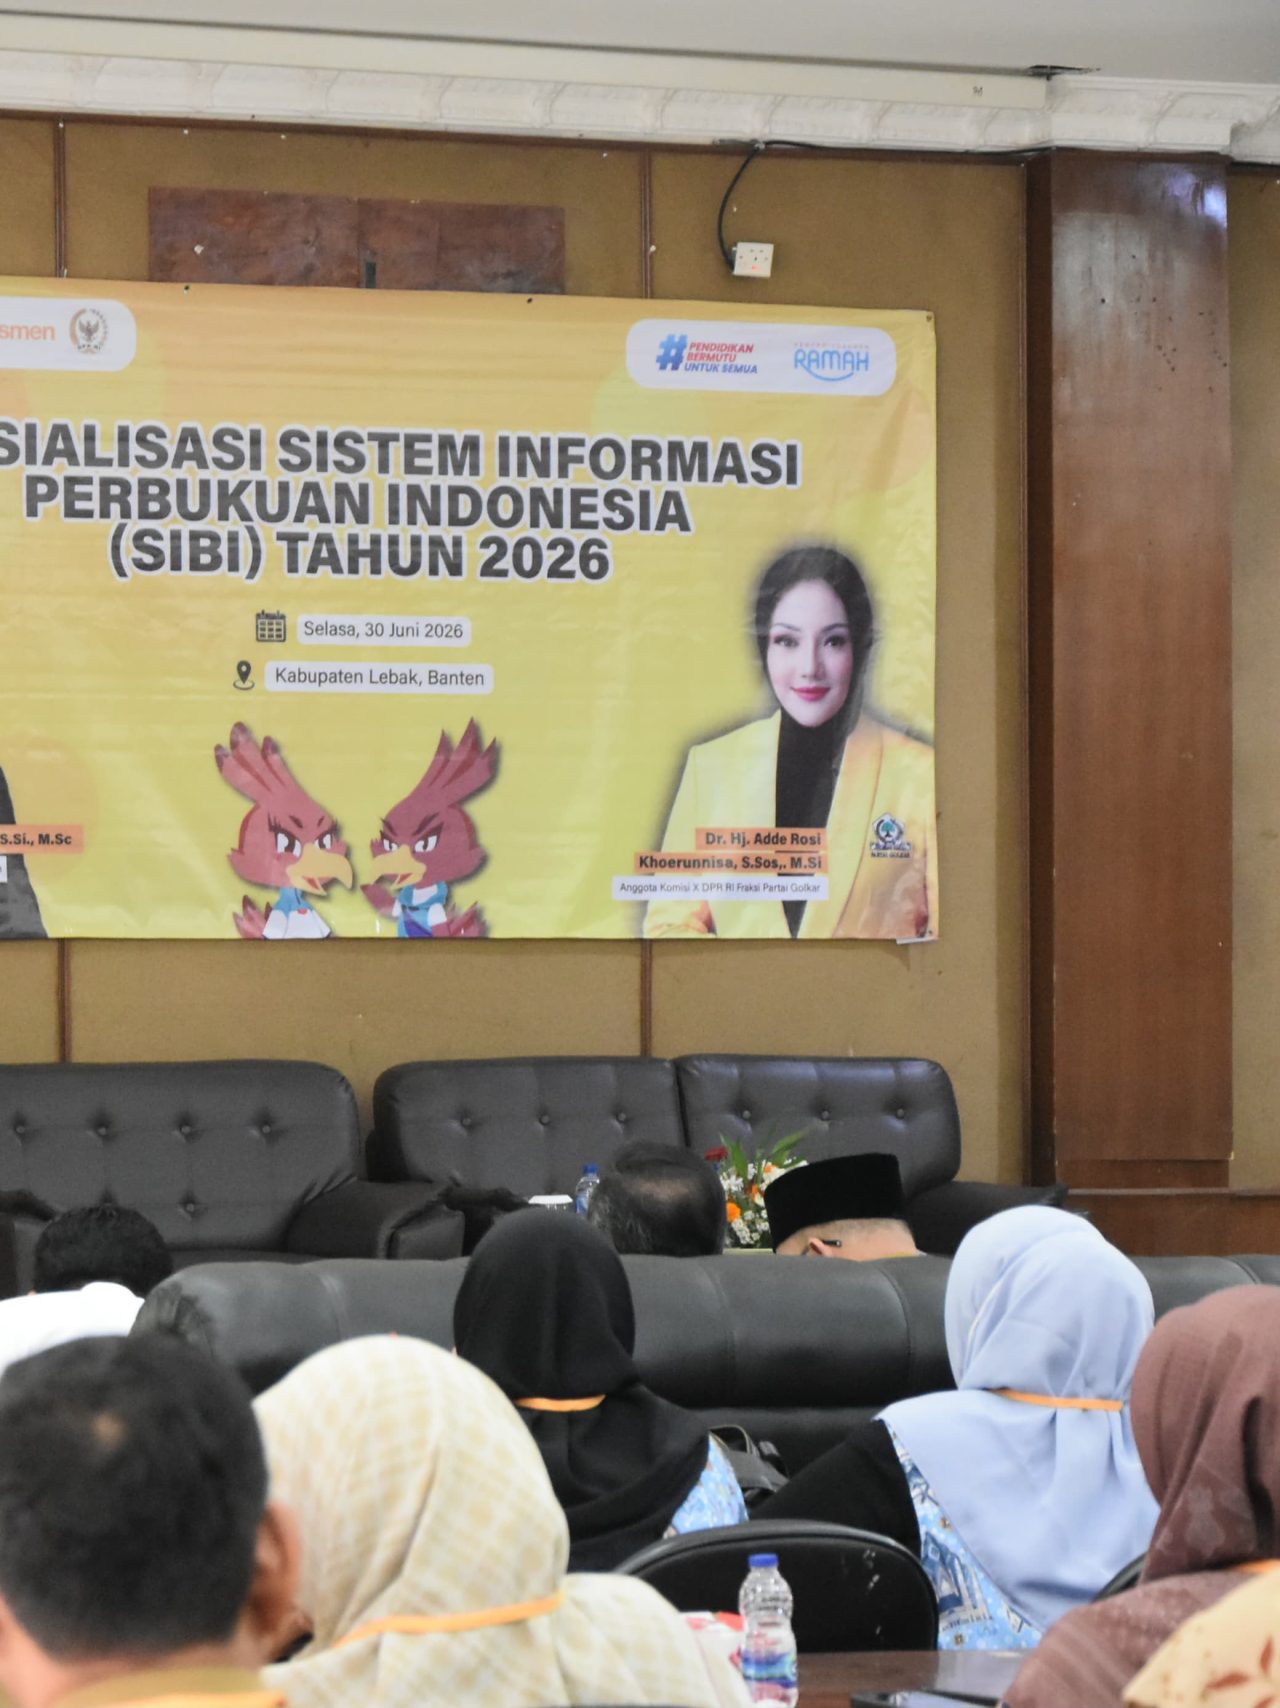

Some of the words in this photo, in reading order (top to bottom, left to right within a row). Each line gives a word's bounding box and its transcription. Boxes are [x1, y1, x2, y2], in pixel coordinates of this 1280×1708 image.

[689, 342, 754, 353] PENDIDIKAN
[686, 352, 736, 362] BERMUTU
[684, 363, 720, 373] UNTUK
[721, 364, 758, 374] SEMUA
[794, 349, 870, 381] RAMAH
[278, 429, 481, 477] SISTEM
[497, 435, 798, 486] INFORMASI
[25, 475, 369, 526] PERBUKUAN
[388, 483, 692, 532] INDONESIA
[111, 522, 262, 580] (SIBI)
[276, 532, 463, 577] TAHUN
[479, 536, 610, 580] 2026
[304, 620, 360, 639] Selasa,
[365, 622, 384, 637] 30
[389, 622, 420, 638] Juni
[424, 624, 463, 638] 2026
[275, 667, 363, 687] Kabupaten
[369, 669, 422, 687] Lebak,
[428, 670, 484, 686] Banten
[0, 833, 34, 847] S.Si.,
[38, 833, 72, 846] M.Sc
[706, 833, 726, 845] Dr.
[731, 833, 750, 848] Hj.
[754, 833, 787, 846] Adde
[791, 833, 821, 846] Rosi
[640, 855, 737, 870] Khoerunnisa,
[791, 856, 821, 869] M.Si
[620, 883, 657, 893] Anggota
[660, 883, 690, 892] Komisi
[693, 883, 699, 892] X
[737, 883, 760, 892] Fraksi
[763, 883, 788, 892] Partai
